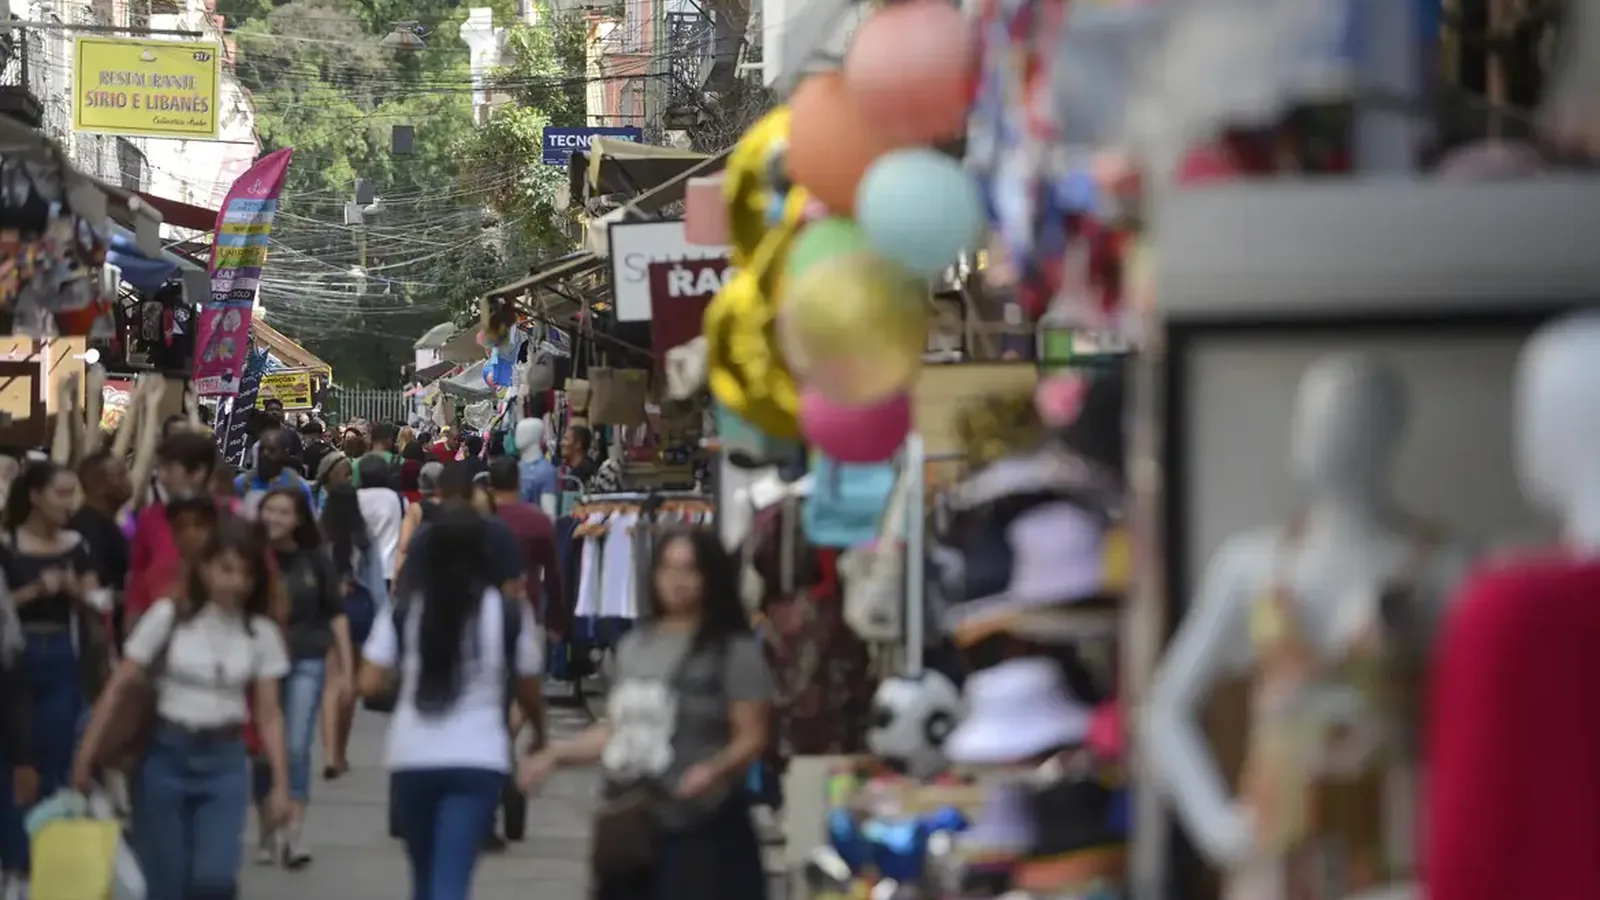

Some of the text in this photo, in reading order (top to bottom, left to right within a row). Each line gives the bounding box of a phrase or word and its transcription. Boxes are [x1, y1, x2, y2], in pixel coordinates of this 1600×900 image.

[99, 70, 197, 90] RESTAURANTE
[131, 92, 140, 109] E
[146, 94, 209, 114] LIBANÊS
